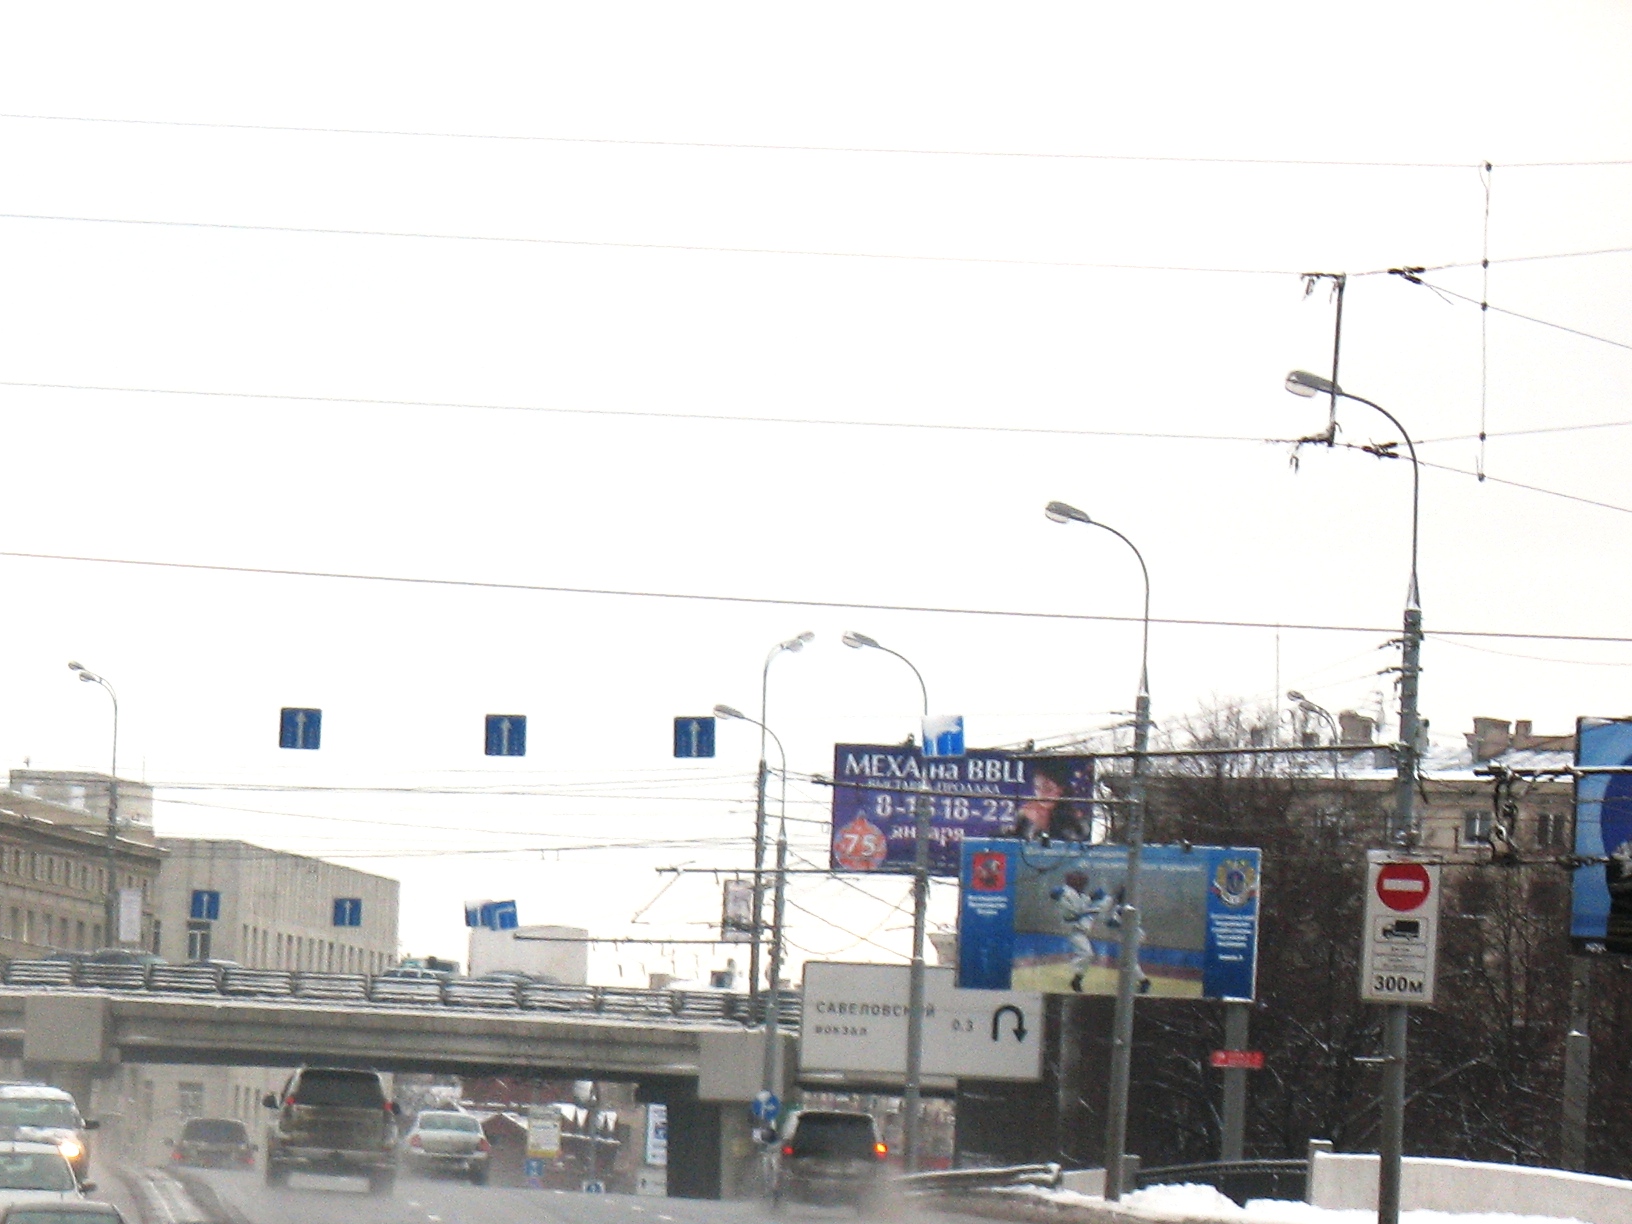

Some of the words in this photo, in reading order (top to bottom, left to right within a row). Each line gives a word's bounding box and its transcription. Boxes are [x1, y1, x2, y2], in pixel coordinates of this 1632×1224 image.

[844, 753, 919, 778] МЕХА
[929, 761, 959, 780] на
[969, 759, 1026, 784] ВВЦ
[842, 833, 876, 856] 75
[890, 824, 965, 847] янаря
[816, 1001, 936, 1019] САВЕЛОВСКЙ
